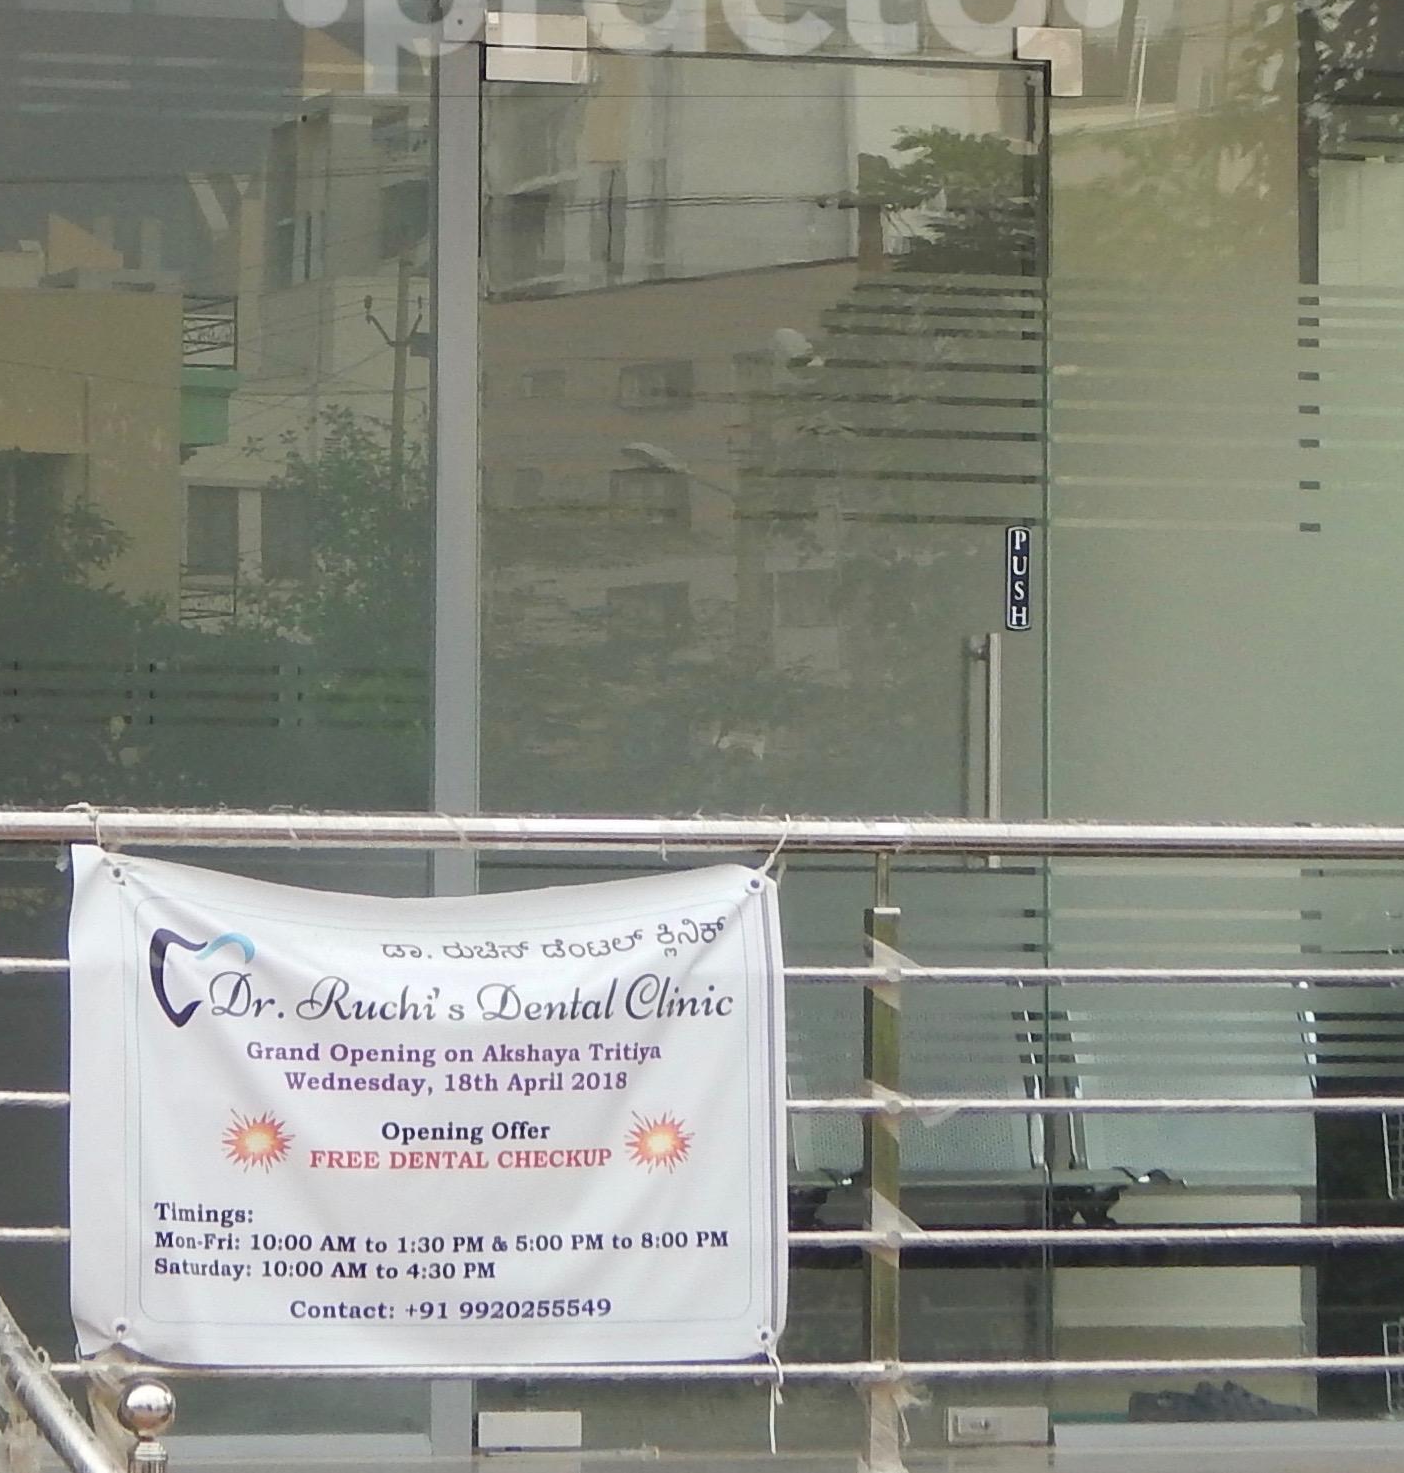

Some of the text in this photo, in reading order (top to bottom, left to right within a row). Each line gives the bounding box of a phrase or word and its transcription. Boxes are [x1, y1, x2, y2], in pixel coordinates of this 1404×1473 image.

[1012, 531, 1028, 626] PUSH
[210, 972, 733, 1020] Dr. Ruchi's Dental Clinic
[247, 1042, 320, 1061] Grand
[330, 1044, 435, 1067] Opening
[482, 1044, 580, 1066] Akshaya
[589, 1043, 661, 1065] Tritiya
[285, 1072, 627, 1096] Wednesday, 18th April 2018
[382, 1121, 550, 1145] Opening Offer
[310, 1149, 611, 1169] FREE DENTAL CHECKUP
[154, 1203, 252, 1227] Timings:
[155, 1231, 728, 1253] Mon-Fri: 10:00 AM to 1:30 PM & 5:00 PM to 8:00 PM
[155, 1258, 495, 1281] Saturday: 10:00 AM to 4:30 PM
[291, 1299, 611, 1319] Contact: +91 9920255549
